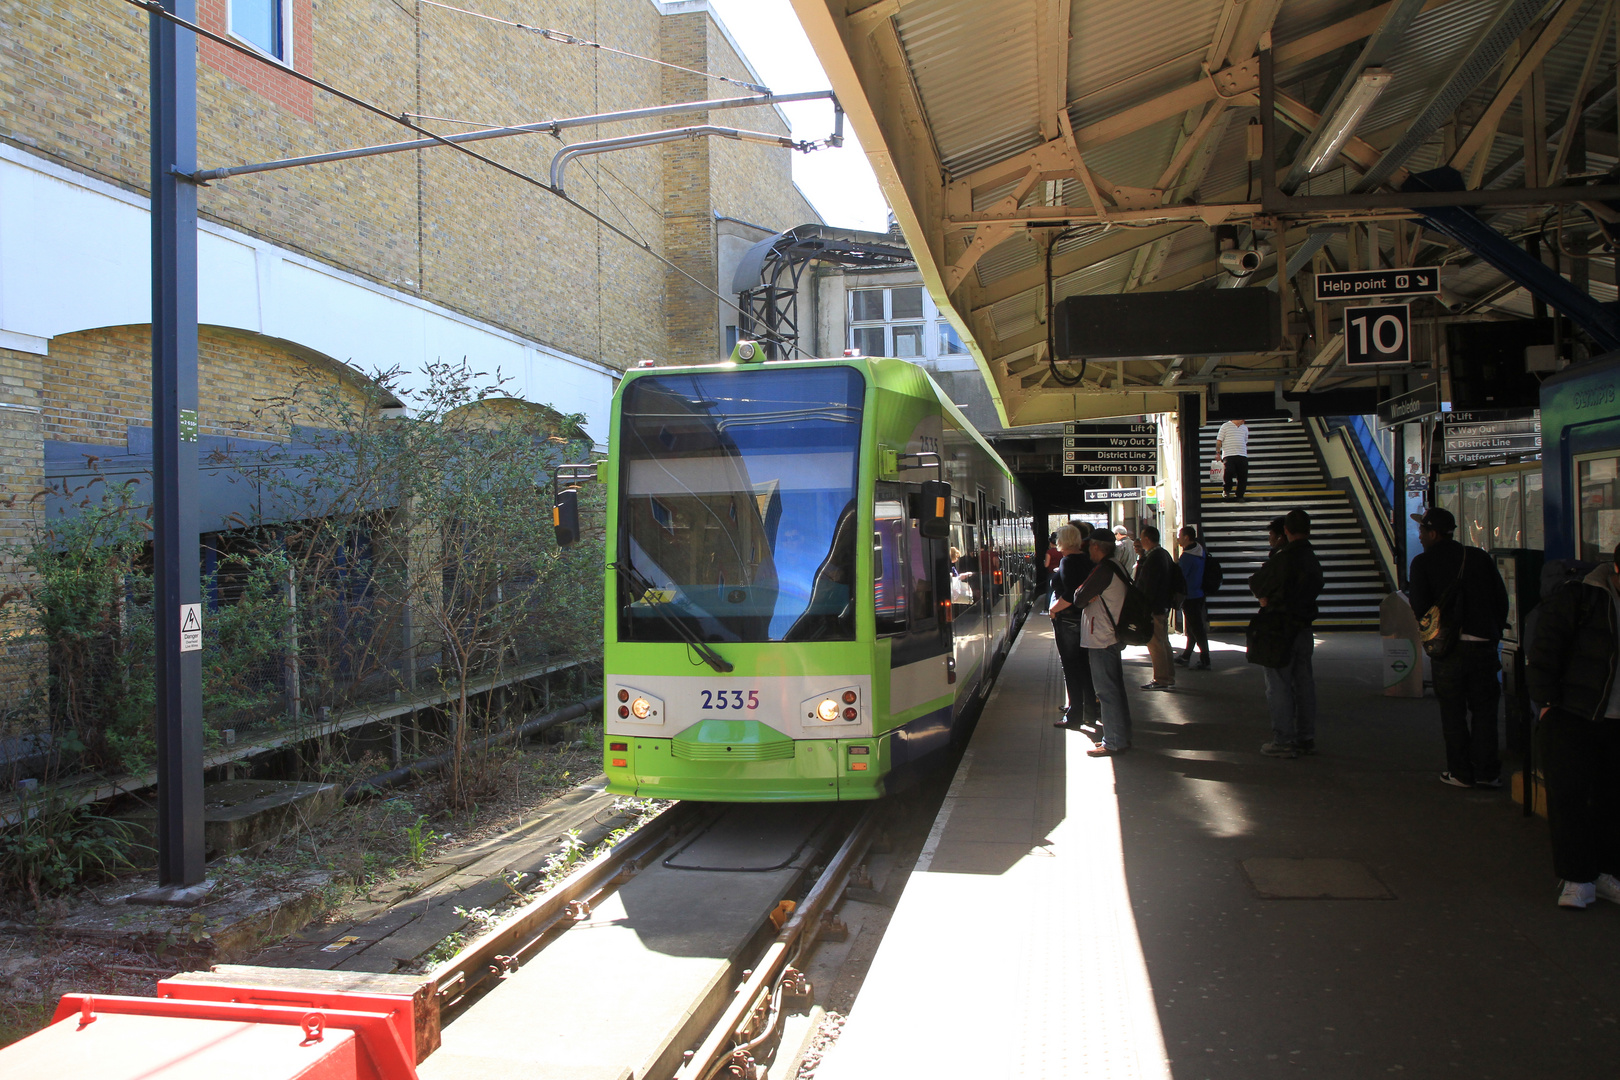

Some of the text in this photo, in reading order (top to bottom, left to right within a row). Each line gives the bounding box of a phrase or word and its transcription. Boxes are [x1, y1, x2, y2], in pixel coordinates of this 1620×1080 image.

[1323, 278, 1387, 293] Help point
[1351, 314, 1404, 355] 10
[1574, 384, 1615, 409] OLYMPIC
[1391, 398, 1420, 418] Wimbledon
[1130, 424, 1145, 432] Lift
[1458, 427, 1476, 435] Way
[920, 436, 938, 453] 2535
[1110, 438, 1145, 446] Way Out
[1097, 451, 1146, 459] District Line
[1082, 464, 1122, 472] Platforms
[1124, 464, 1127, 472] 1
[1407, 475, 1427, 487] 2-6
[700, 689, 760, 710] 2535
